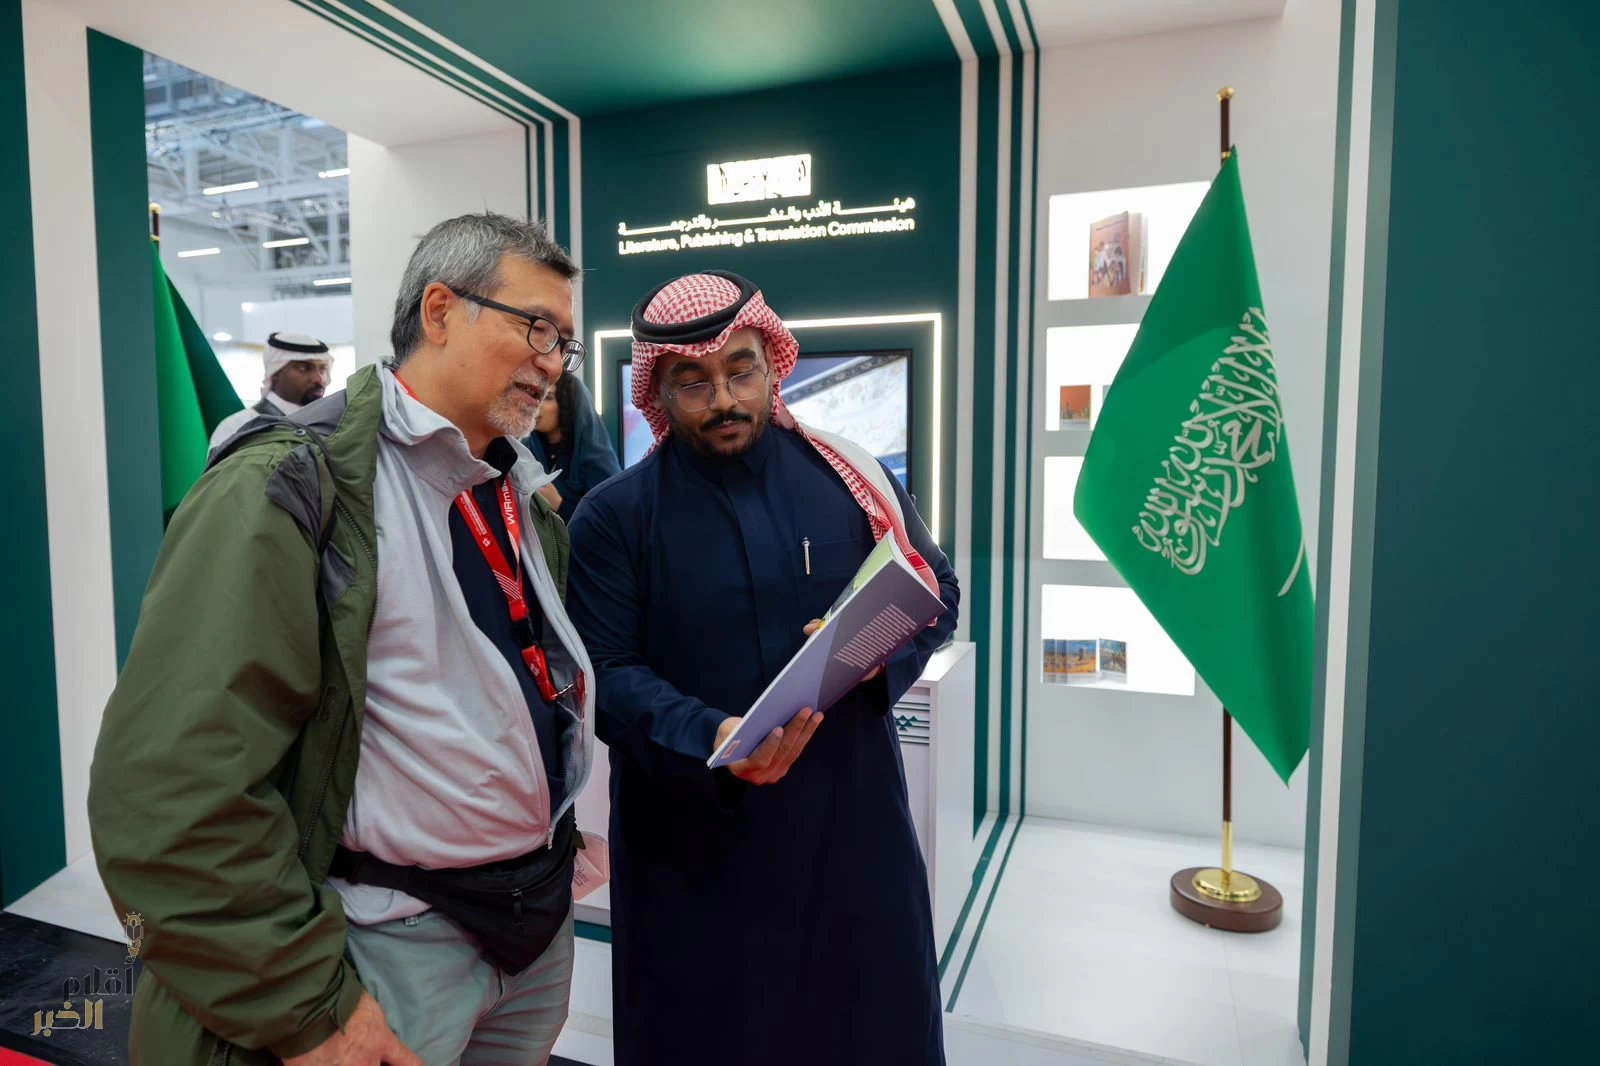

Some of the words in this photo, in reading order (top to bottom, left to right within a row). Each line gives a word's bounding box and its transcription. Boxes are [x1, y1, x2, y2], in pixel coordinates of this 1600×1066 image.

[680, 231, 743, 249] Publishing
[743, 228, 755, 243] &
[754, 224, 827, 242] Translation
[827, 216, 915, 236] Commission
